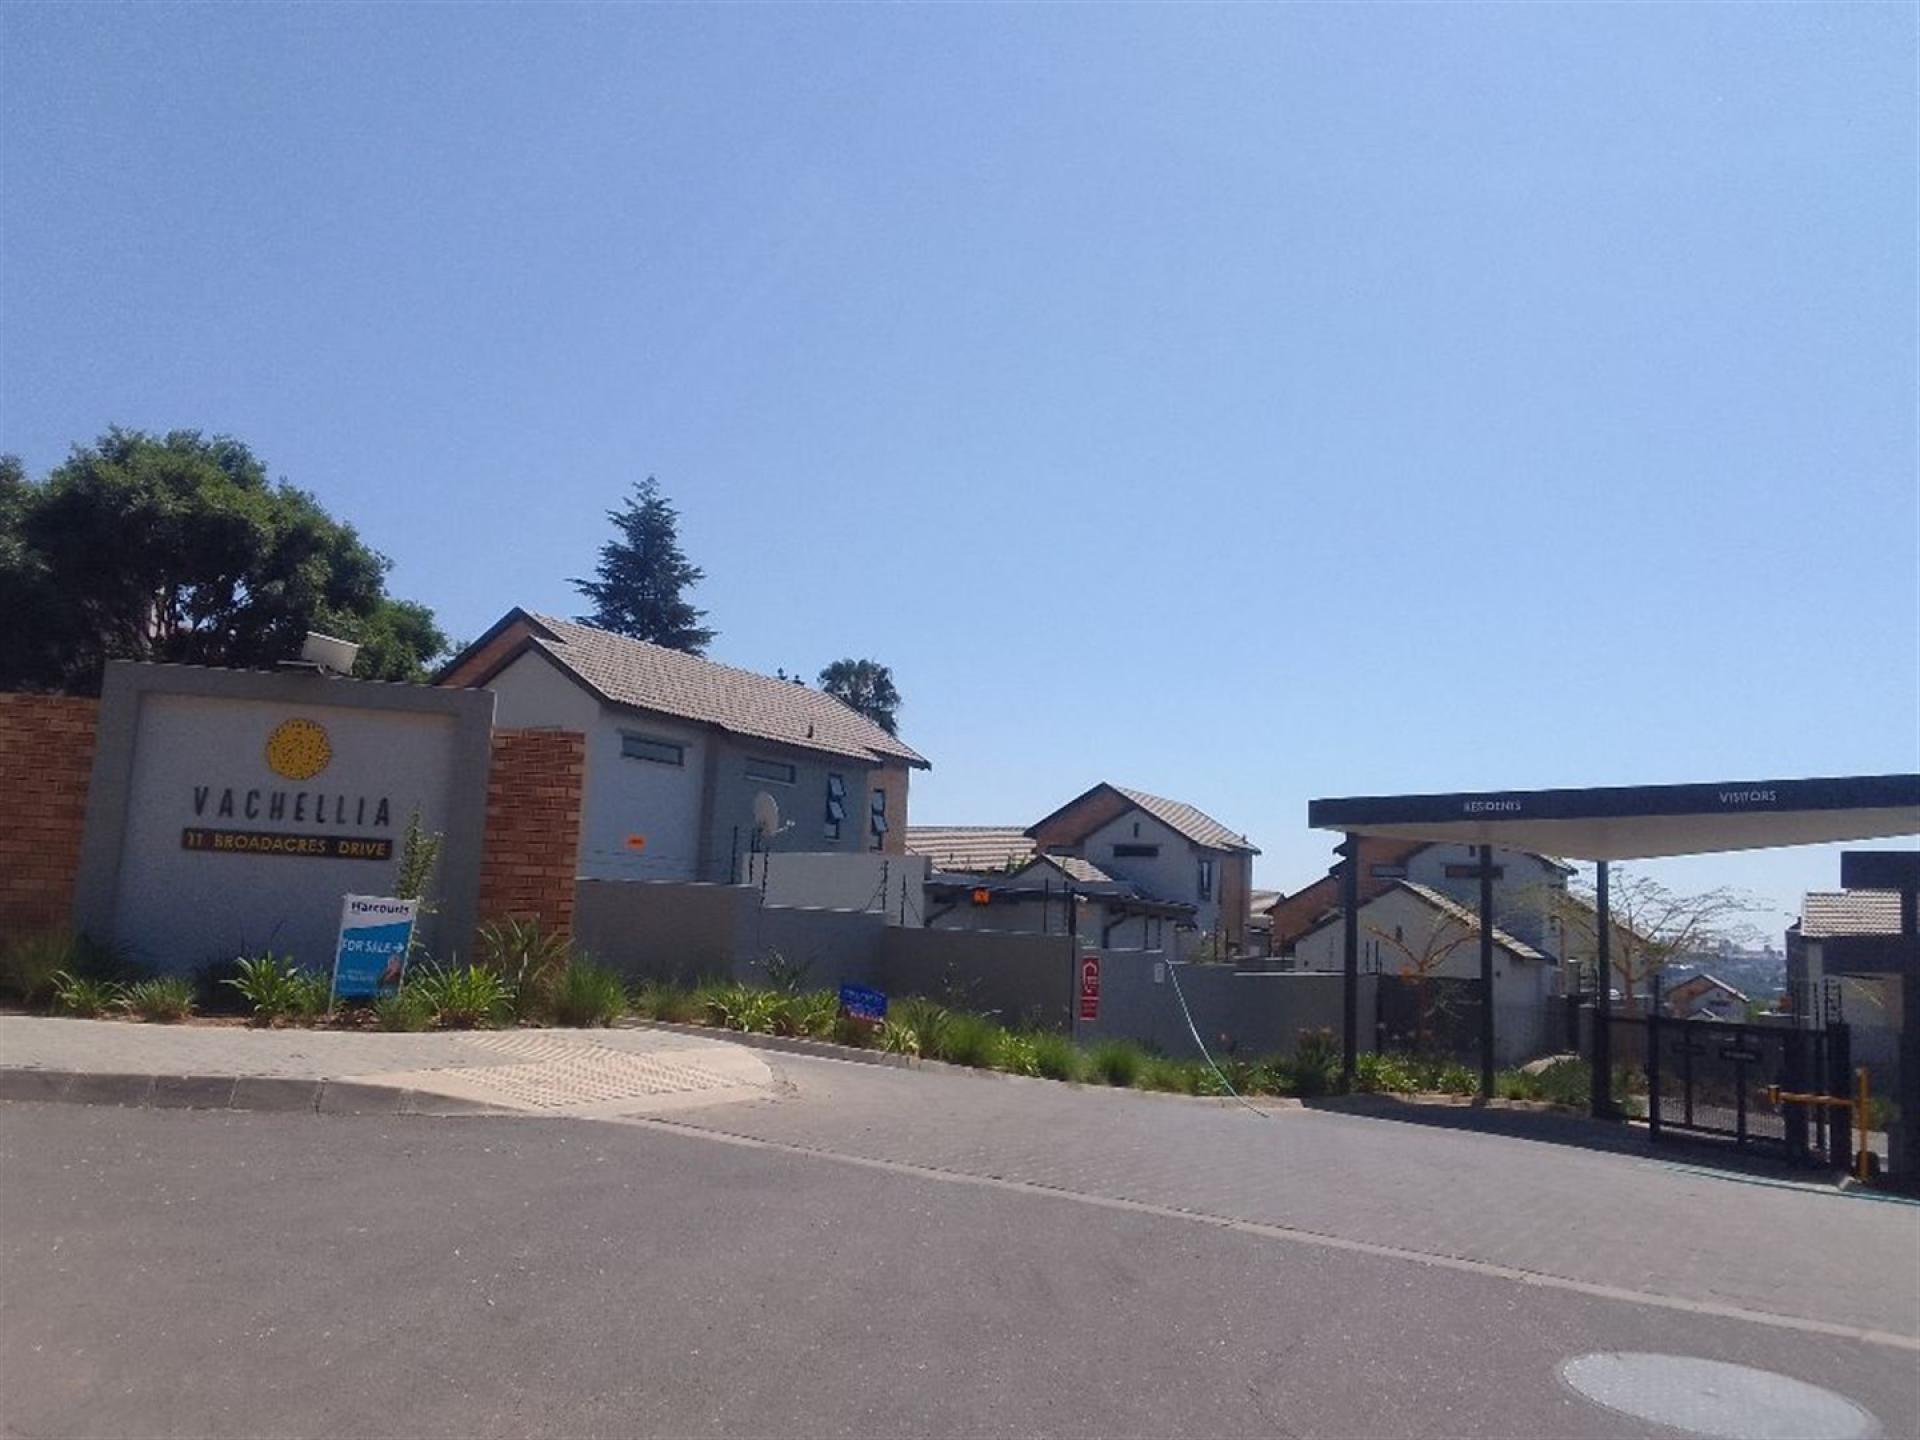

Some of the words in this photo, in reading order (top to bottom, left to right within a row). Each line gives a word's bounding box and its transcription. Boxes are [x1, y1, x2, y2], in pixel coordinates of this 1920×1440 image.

[1719, 790, 1777, 804] VISITORS
[194, 786, 390, 826] VACHELLIA
[187, 831, 203, 847] 11
[214, 832, 326, 854] BROADACRES
[338, 840, 386, 856] DRIVE
[351, 902, 410, 913] Harcourts
[343, 940, 363, 952] FOR
[364, 940, 391, 953] SALE
